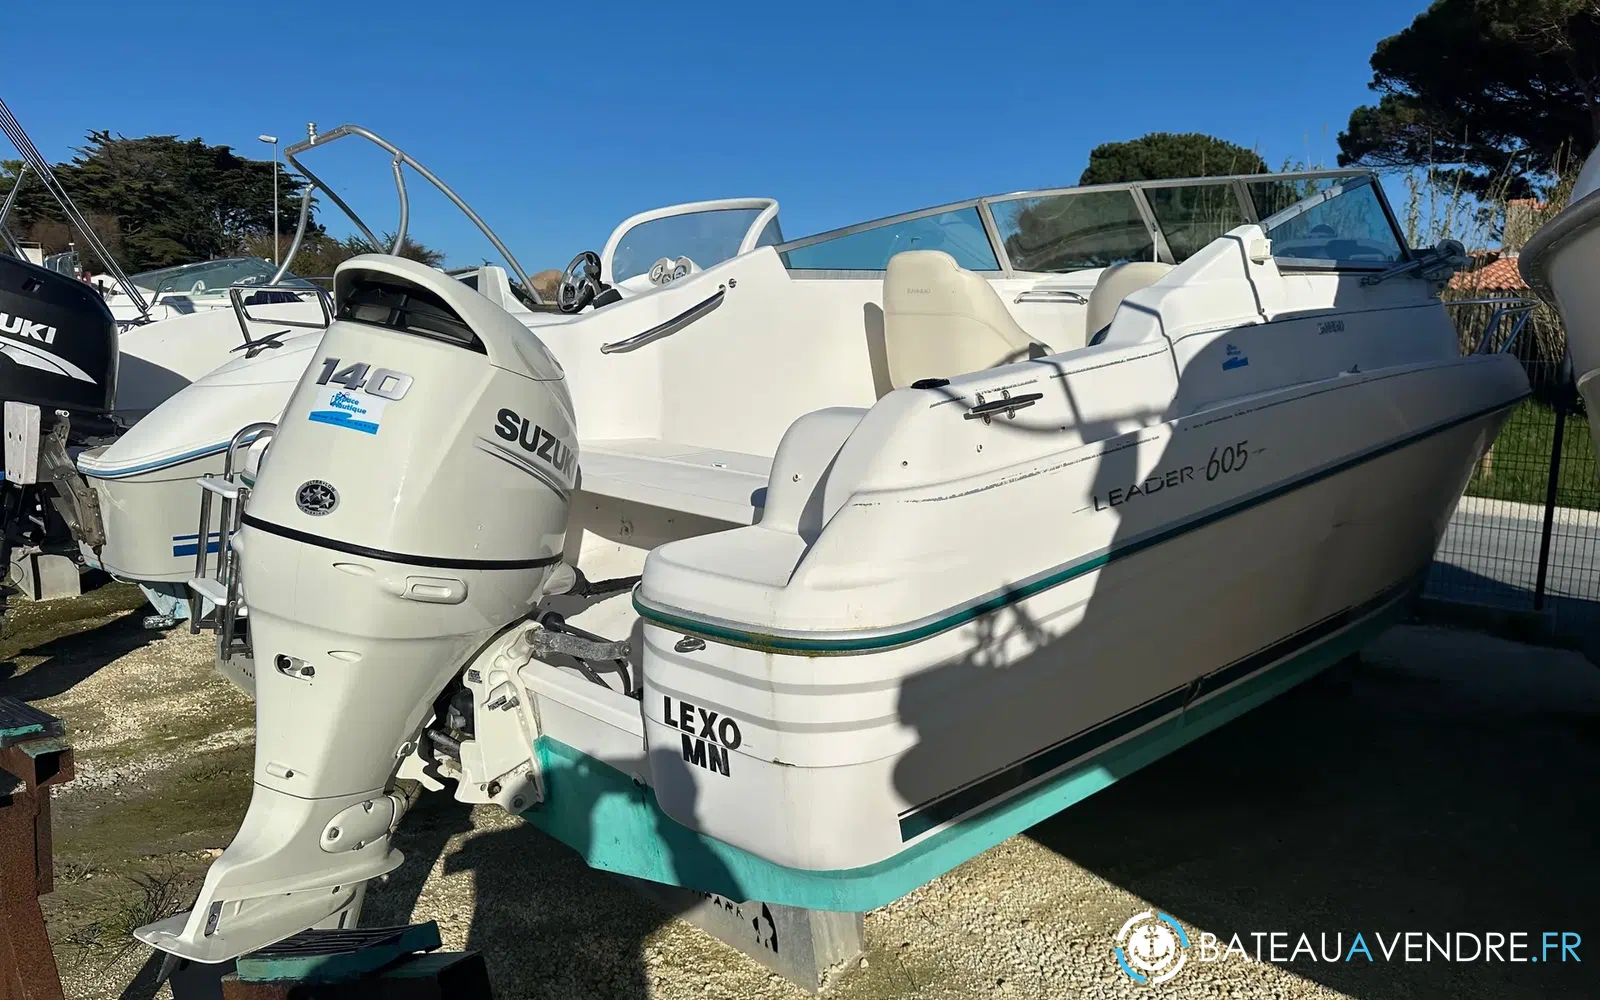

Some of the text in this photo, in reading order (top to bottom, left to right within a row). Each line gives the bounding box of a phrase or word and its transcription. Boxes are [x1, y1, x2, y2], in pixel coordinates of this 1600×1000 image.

[316, 357, 415, 401] 140
[494, 408, 577, 483] SUZUKI
[1093, 440, 1249, 512] LEADER 605
[663, 695, 742, 750] LEXO
[681, 733, 730, 777] MN
